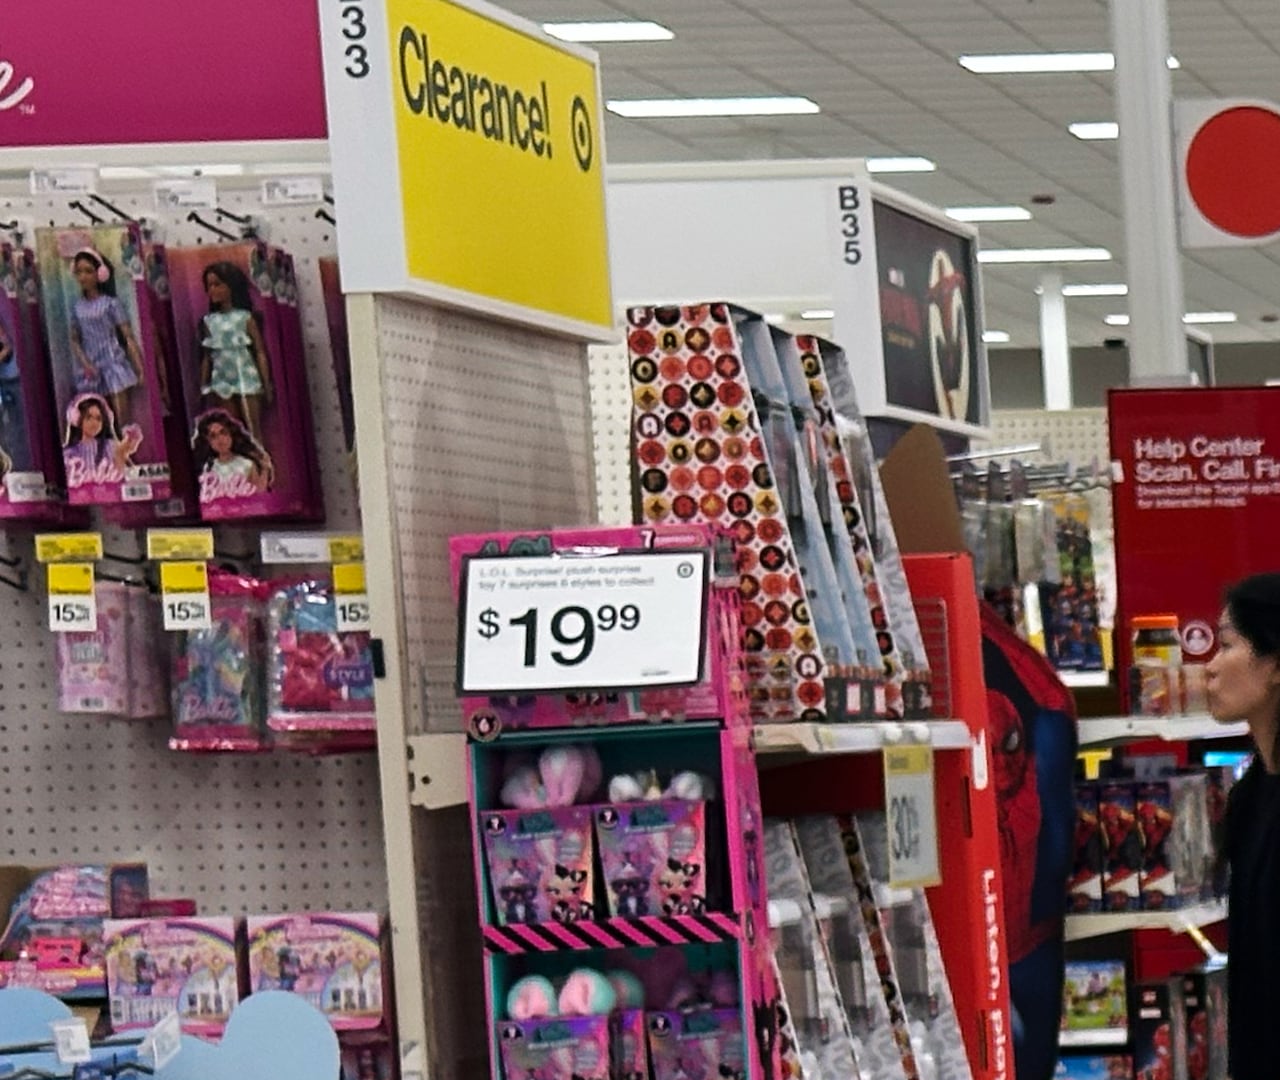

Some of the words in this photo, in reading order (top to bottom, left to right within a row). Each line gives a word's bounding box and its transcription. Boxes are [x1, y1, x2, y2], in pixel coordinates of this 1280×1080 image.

[399, 25, 552, 159] Clearance!
[1134, 437, 1186, 462] Help
[1190, 435, 1264, 458] Center
[1135, 460, 1197, 483] Scan.
[1203, 458, 1250, 481] Call.
